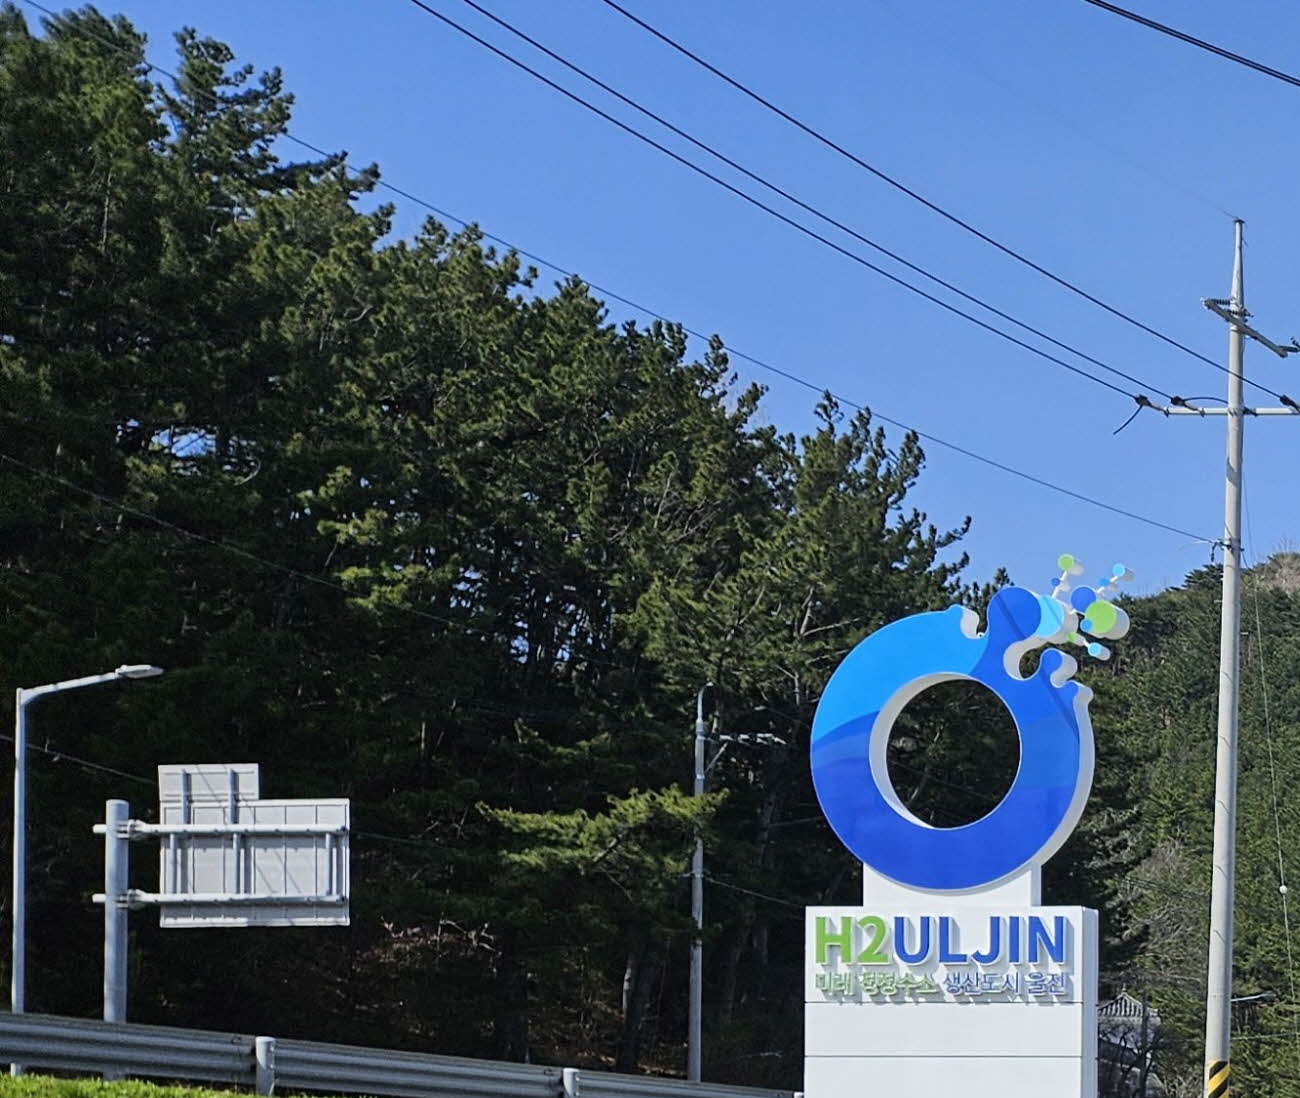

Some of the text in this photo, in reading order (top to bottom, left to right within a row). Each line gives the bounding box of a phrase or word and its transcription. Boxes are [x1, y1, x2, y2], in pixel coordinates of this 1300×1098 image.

[815, 915, 1065, 965] H2ULJIN
[815, 971, 1068, 996] 미래 청정수소 생산도시 울진
